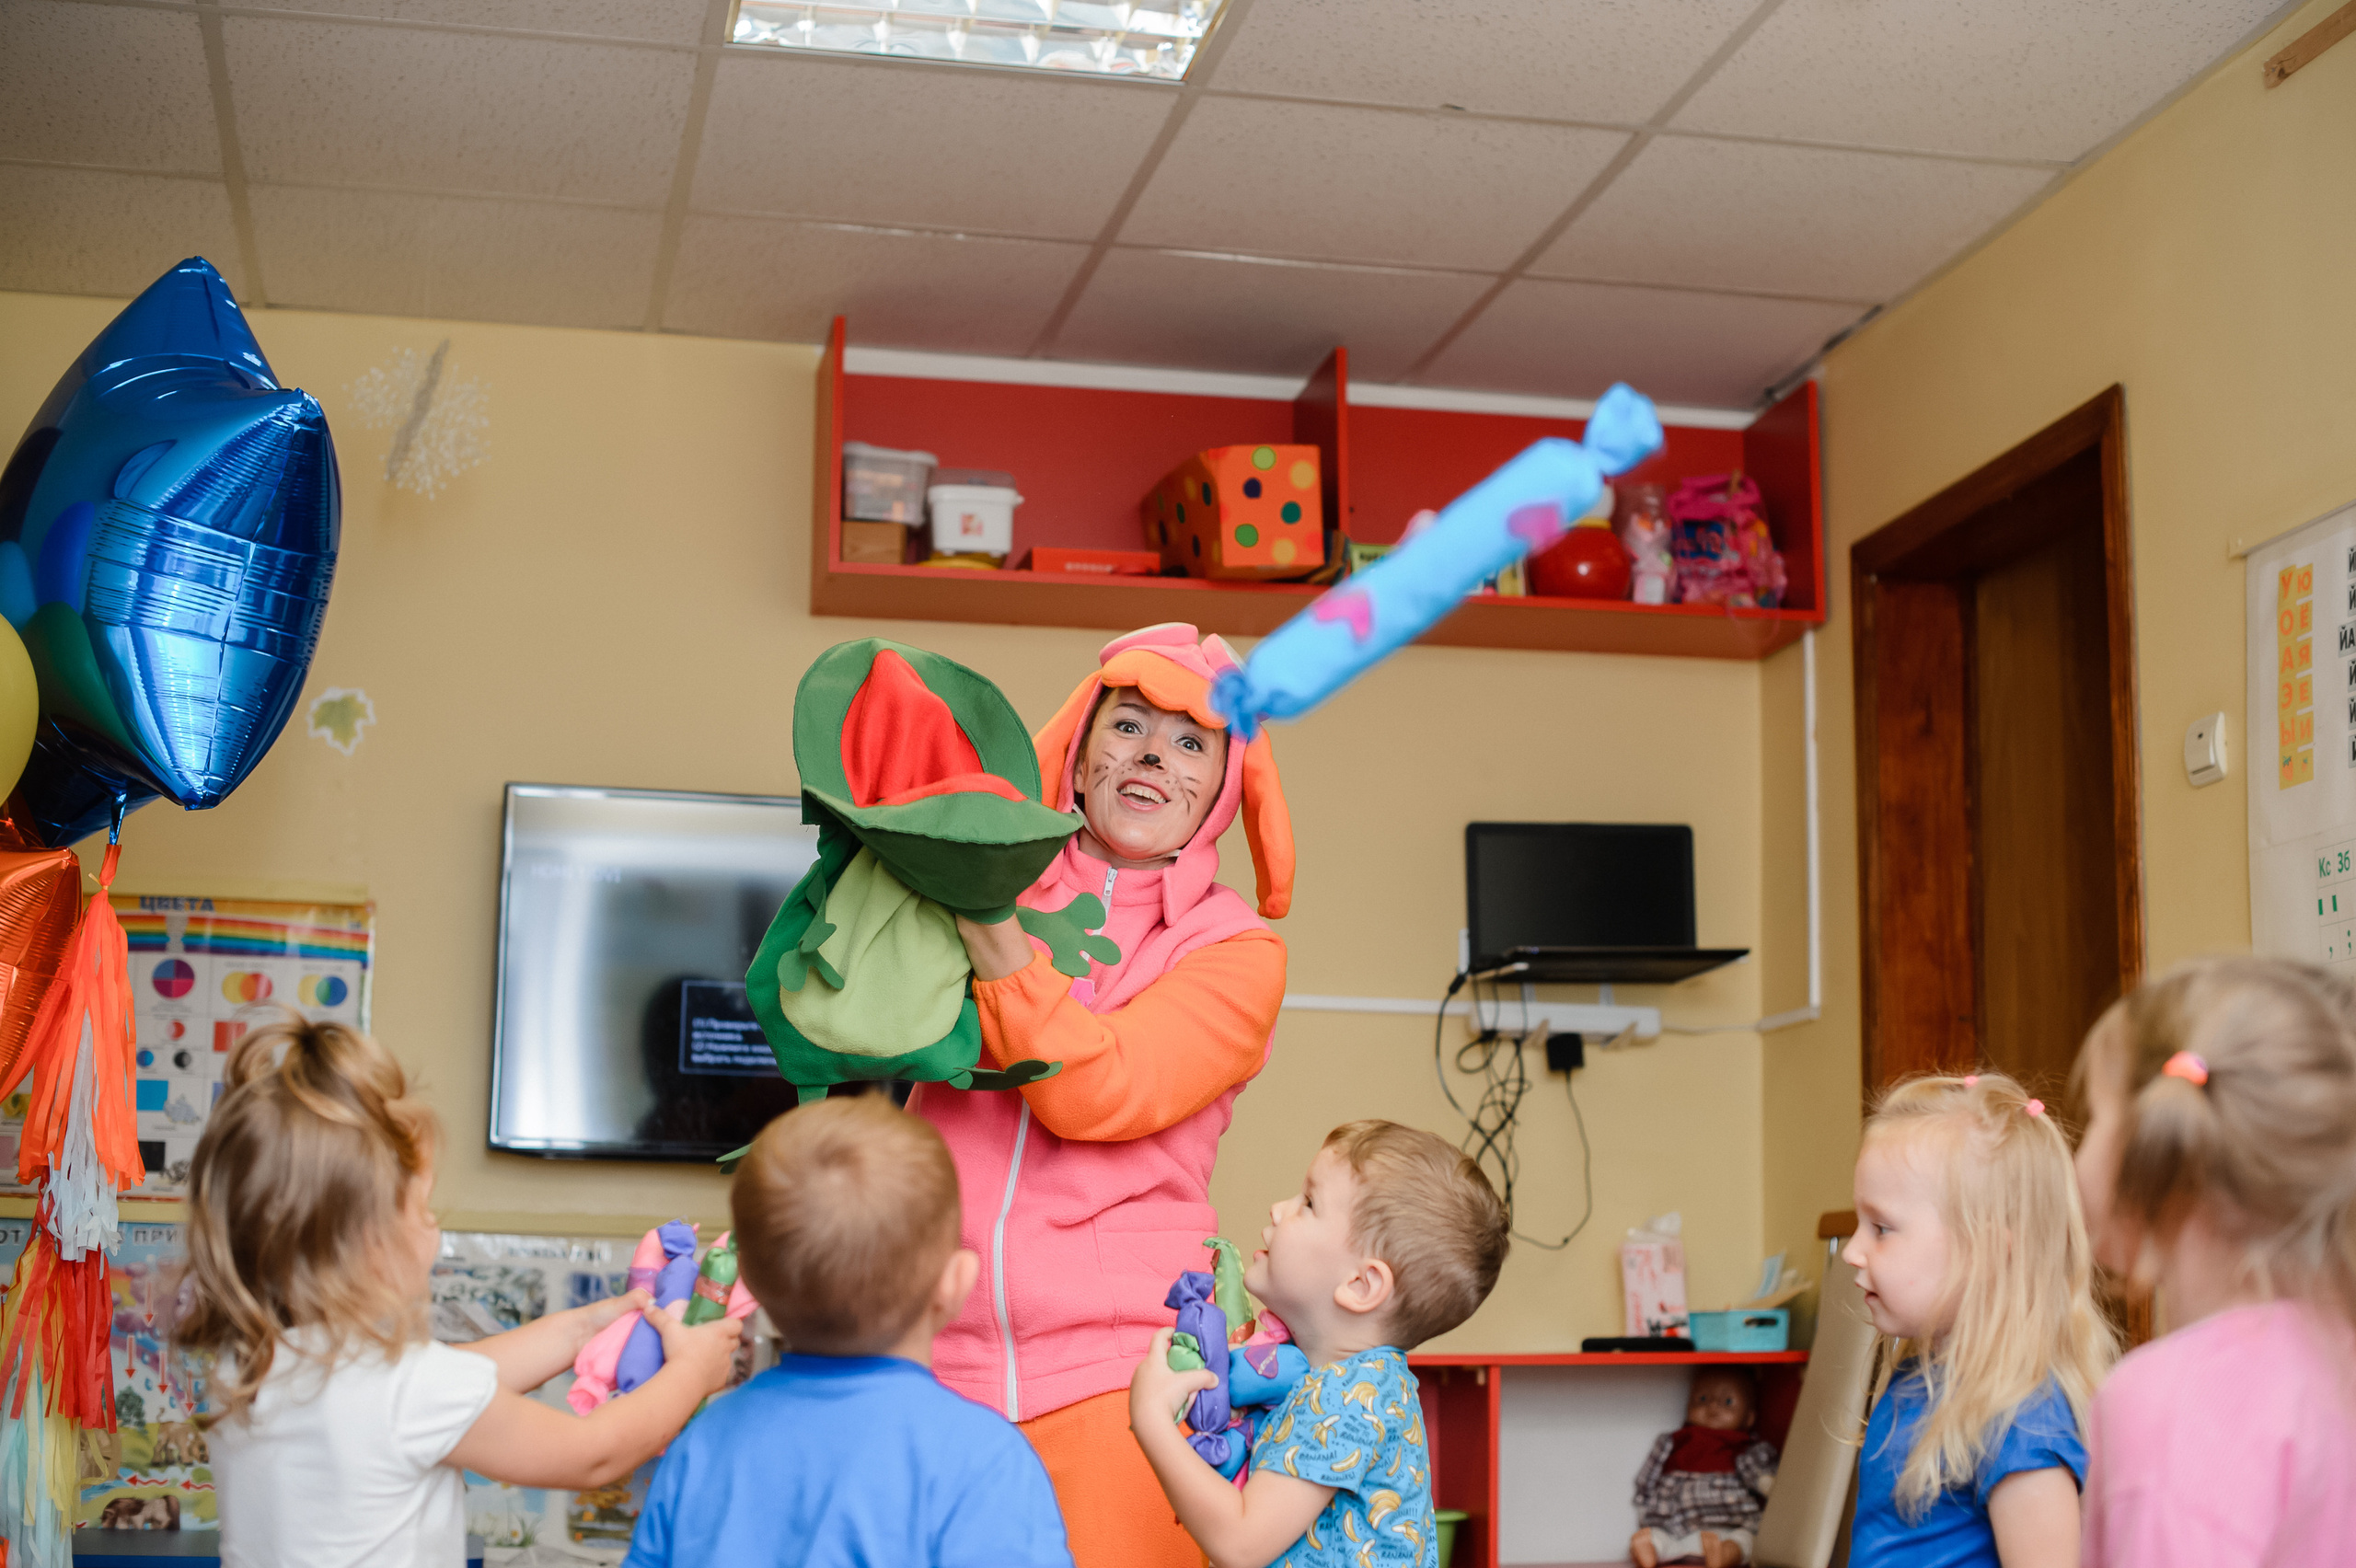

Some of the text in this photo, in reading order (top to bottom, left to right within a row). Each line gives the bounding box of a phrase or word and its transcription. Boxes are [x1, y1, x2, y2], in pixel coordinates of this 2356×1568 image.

[2299, 644, 2310, 667] Я
[2281, 682, 2293, 709] Э
[2281, 717, 2311, 746] Ы И
